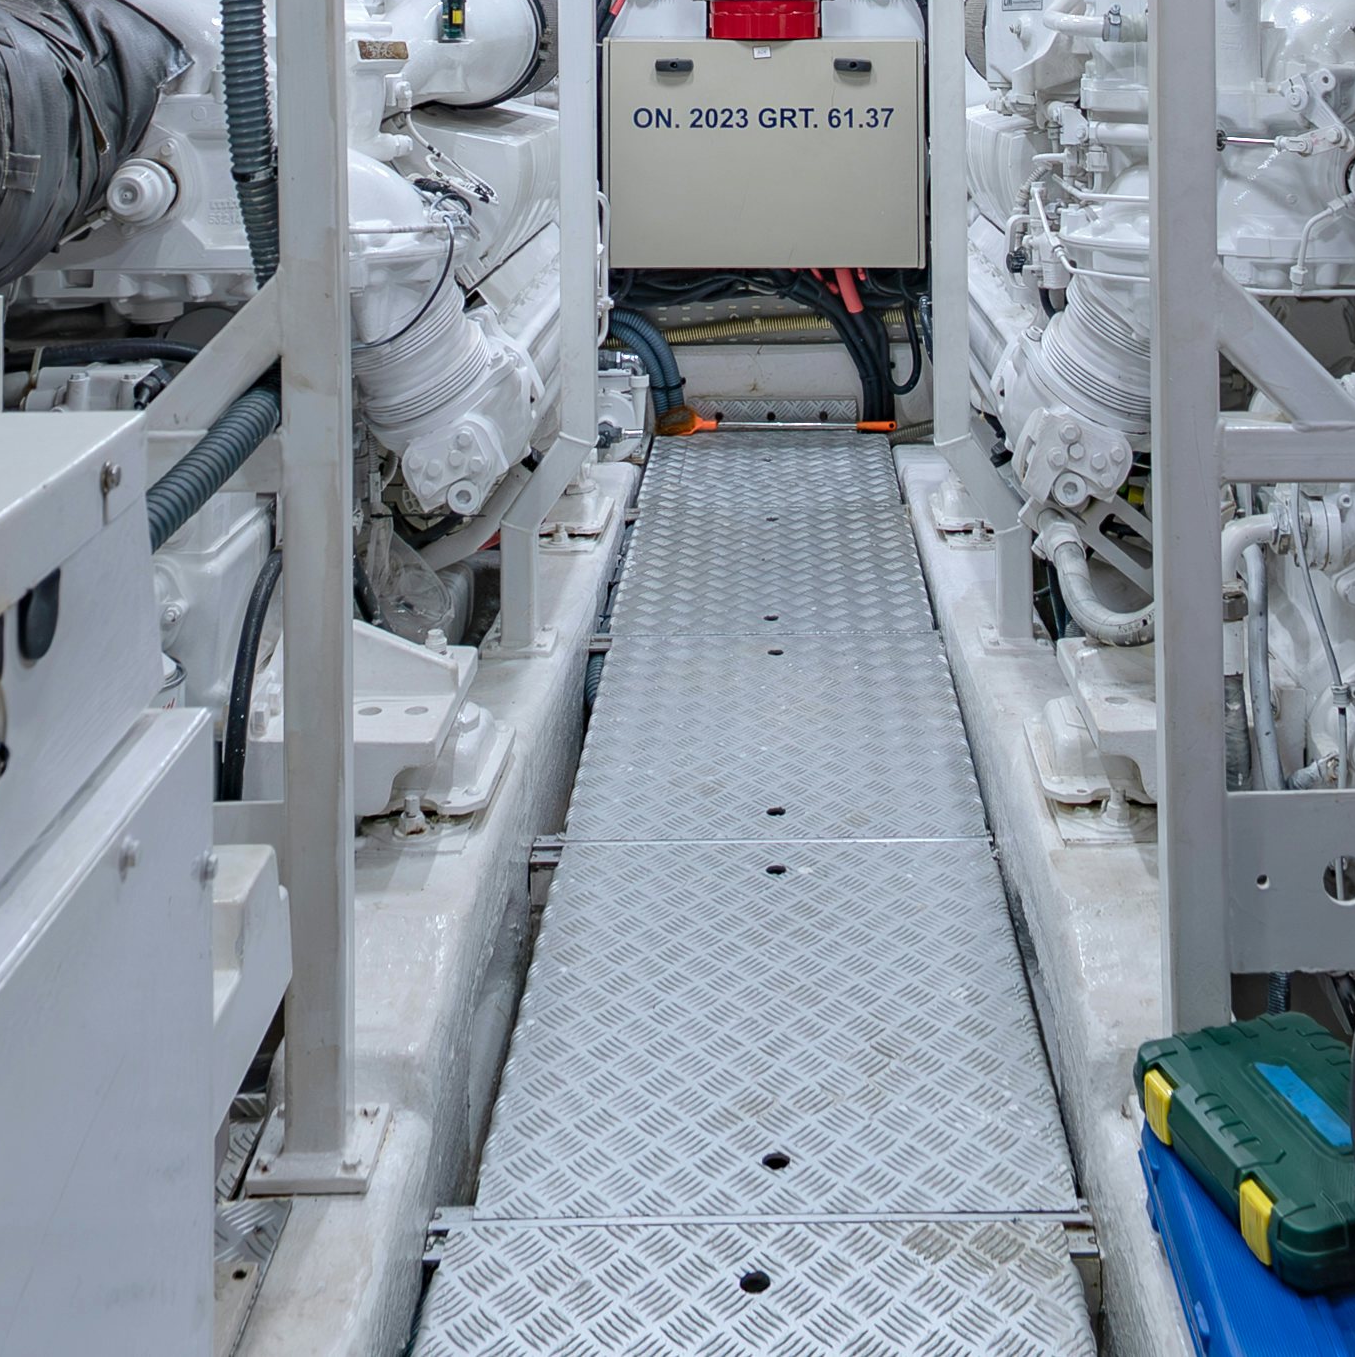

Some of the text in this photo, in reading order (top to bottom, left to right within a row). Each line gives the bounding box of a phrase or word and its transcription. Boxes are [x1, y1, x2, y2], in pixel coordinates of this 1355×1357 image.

[633, 107, 894, 129] ON. 2023 GRT. 61.37
